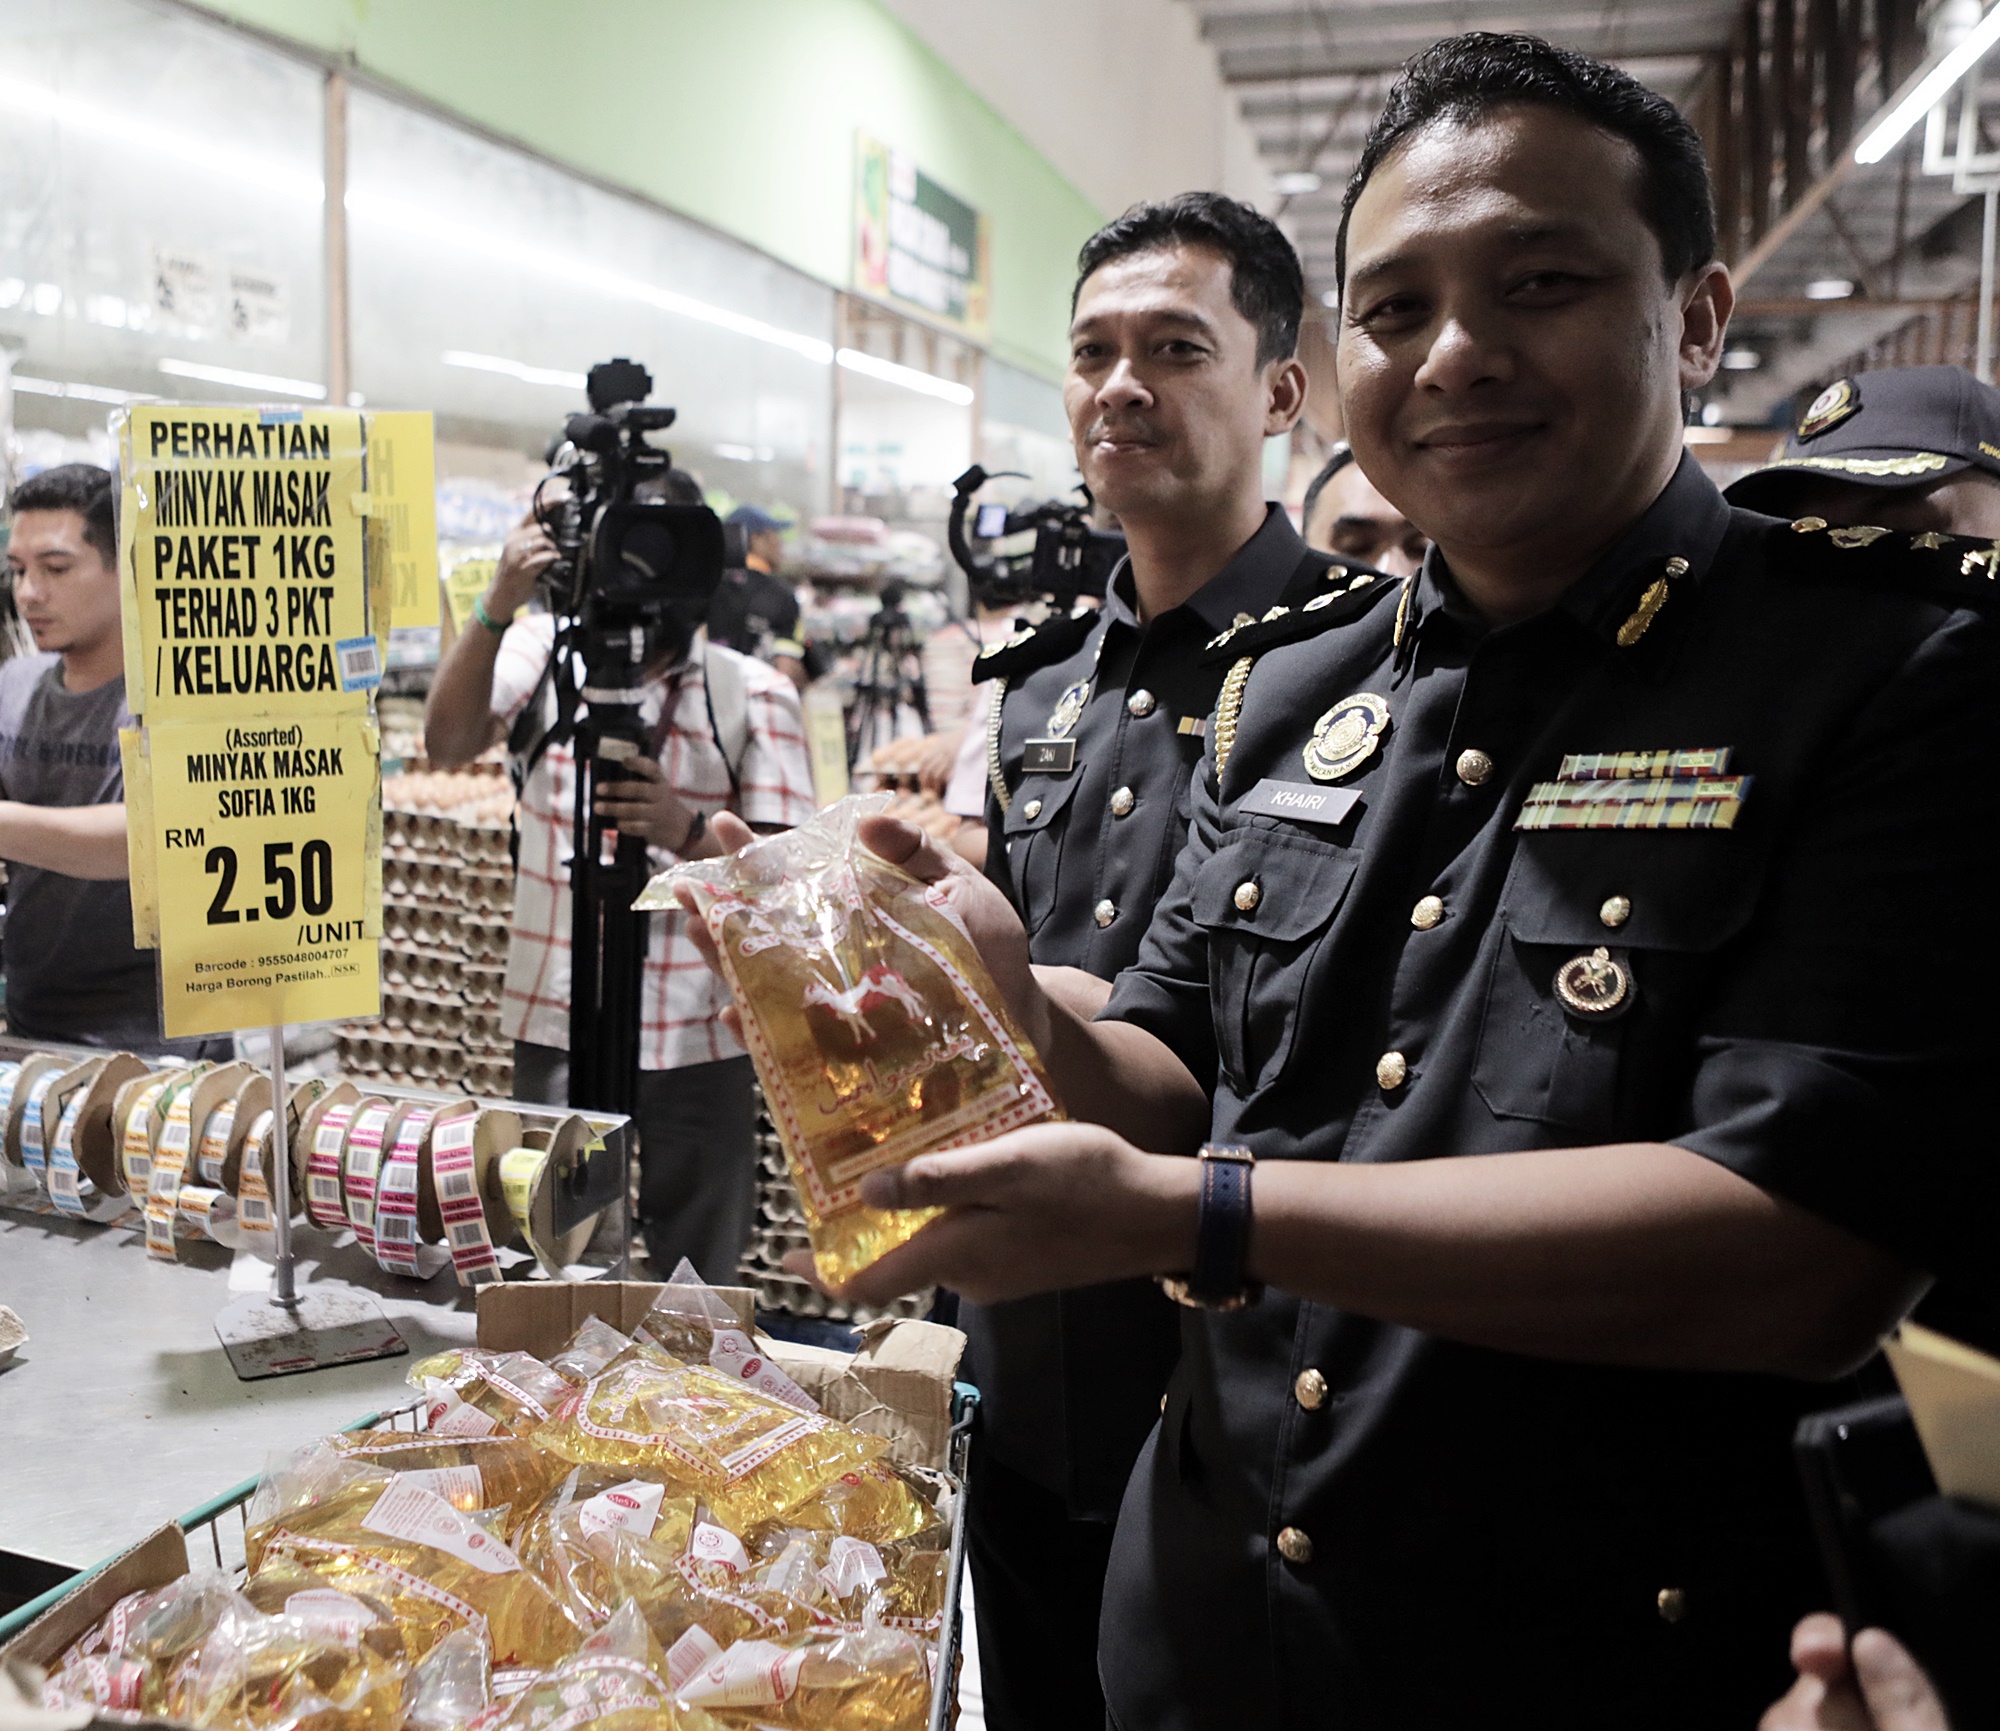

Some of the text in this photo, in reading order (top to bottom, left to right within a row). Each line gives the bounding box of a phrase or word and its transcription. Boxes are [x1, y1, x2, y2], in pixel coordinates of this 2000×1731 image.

[151, 421, 330, 460] PERHATIAN
[155, 470, 332, 528] MINYAK MASAK
[155, 535, 335, 580] PAKET 1KG
[155, 586, 335, 639] TERHAD 3 PKT
[173, 643, 337, 696] KELUARGA
[225, 725, 303, 751] (Assorted)
[187, 748, 343, 783] MINYAK MASAK
[218, 786, 316, 819] SOFIA 1KG
[1270, 790, 1328, 811] KHAIRI
[165, 827, 206, 849] RM
[204, 839, 334, 926] 2.50
[297, 920, 364, 946] /UNIT
[195, 958, 248, 974] Barcode
[258, 948, 349, 968] 9555048004707
[185, 978, 223, 994] Harga
[226, 974, 272, 990] Borong
[607, 1494, 641, 1509] MeSTI
